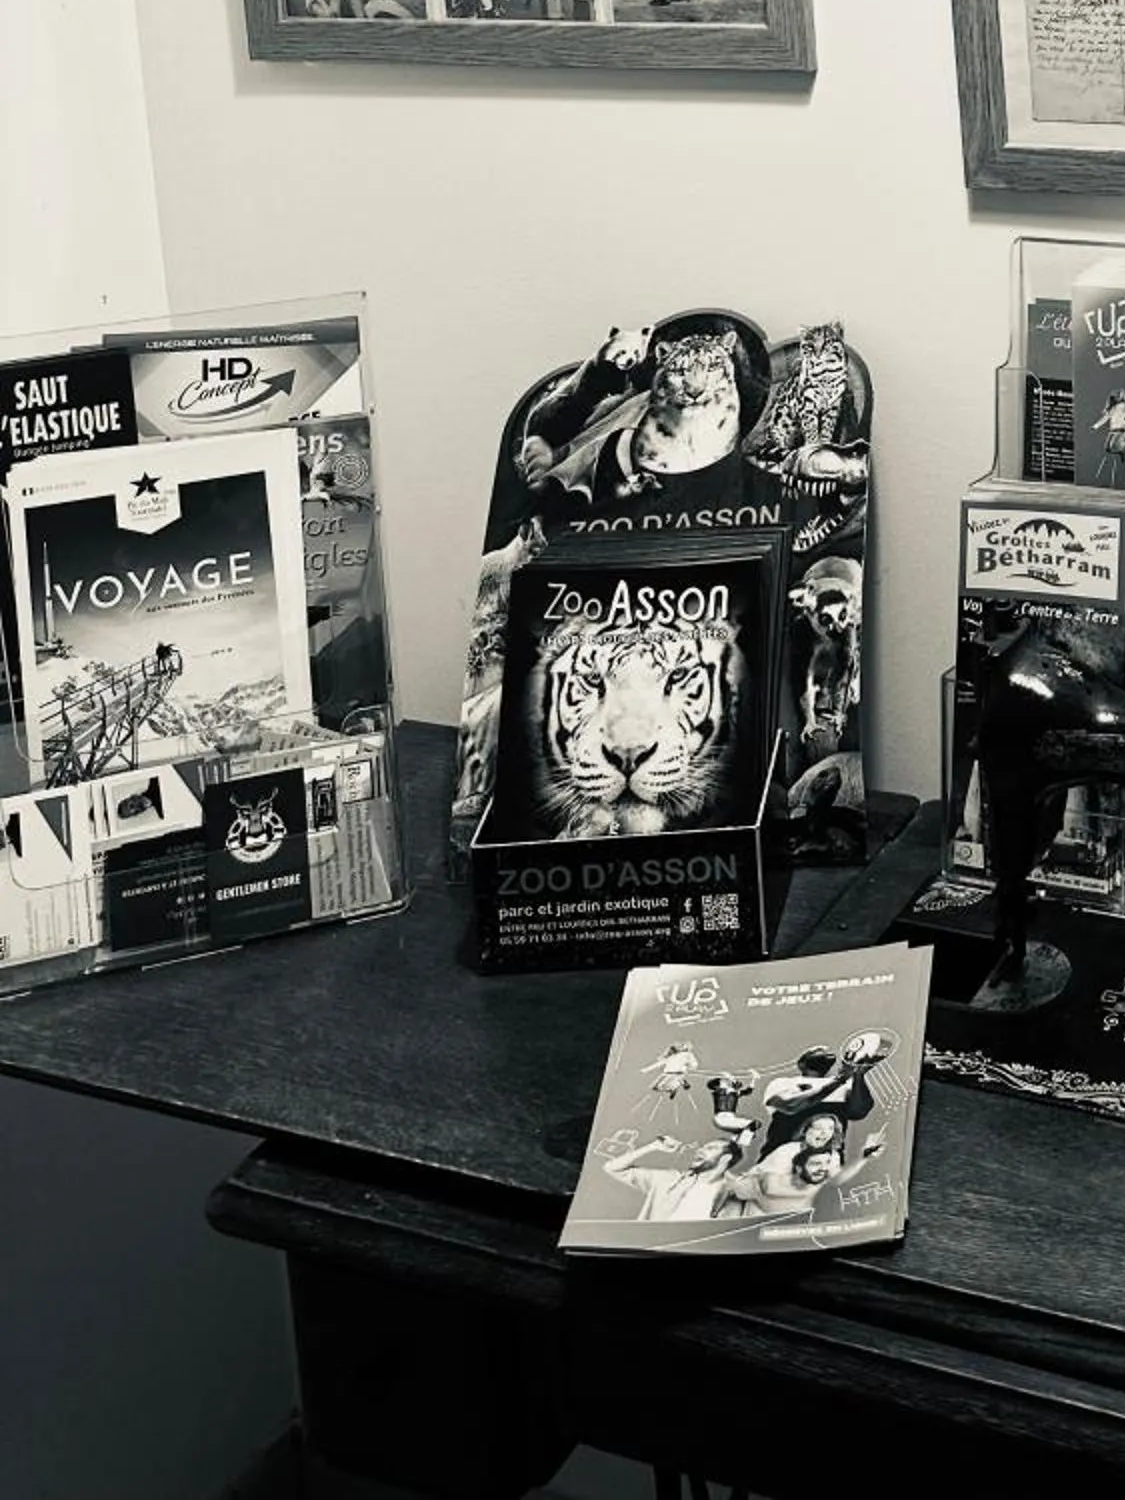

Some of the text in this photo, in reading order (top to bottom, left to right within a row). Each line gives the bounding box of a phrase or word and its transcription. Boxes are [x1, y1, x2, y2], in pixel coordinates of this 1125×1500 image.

[202, 357, 252, 381] HD
[14, 375, 68, 410] SAUT
[168, 367, 261, 410] Concept
[0, 402, 121, 448] 'ELASTIQUE
[986, 531, 1050, 549] Grottes
[977, 547, 1111, 580] Bétharram
[55, 552, 254, 614] VOYAGE
[543, 582, 602, 620] Zoo
[1021, 602, 1063, 619] Centre
[1085, 608, 1119, 626] Terre
[216, 879, 269, 901] GENTLEMEN
[271, 873, 301, 890] STORE
[498, 854, 737, 895] ZOO D'ASSON
[499, 897, 669, 920] parc et jardin exotique
[751, 973, 895, 996] VOTRE TERRAIN
[747, 997, 772, 1007] DE
[775, 993, 823, 1006] JEUX
